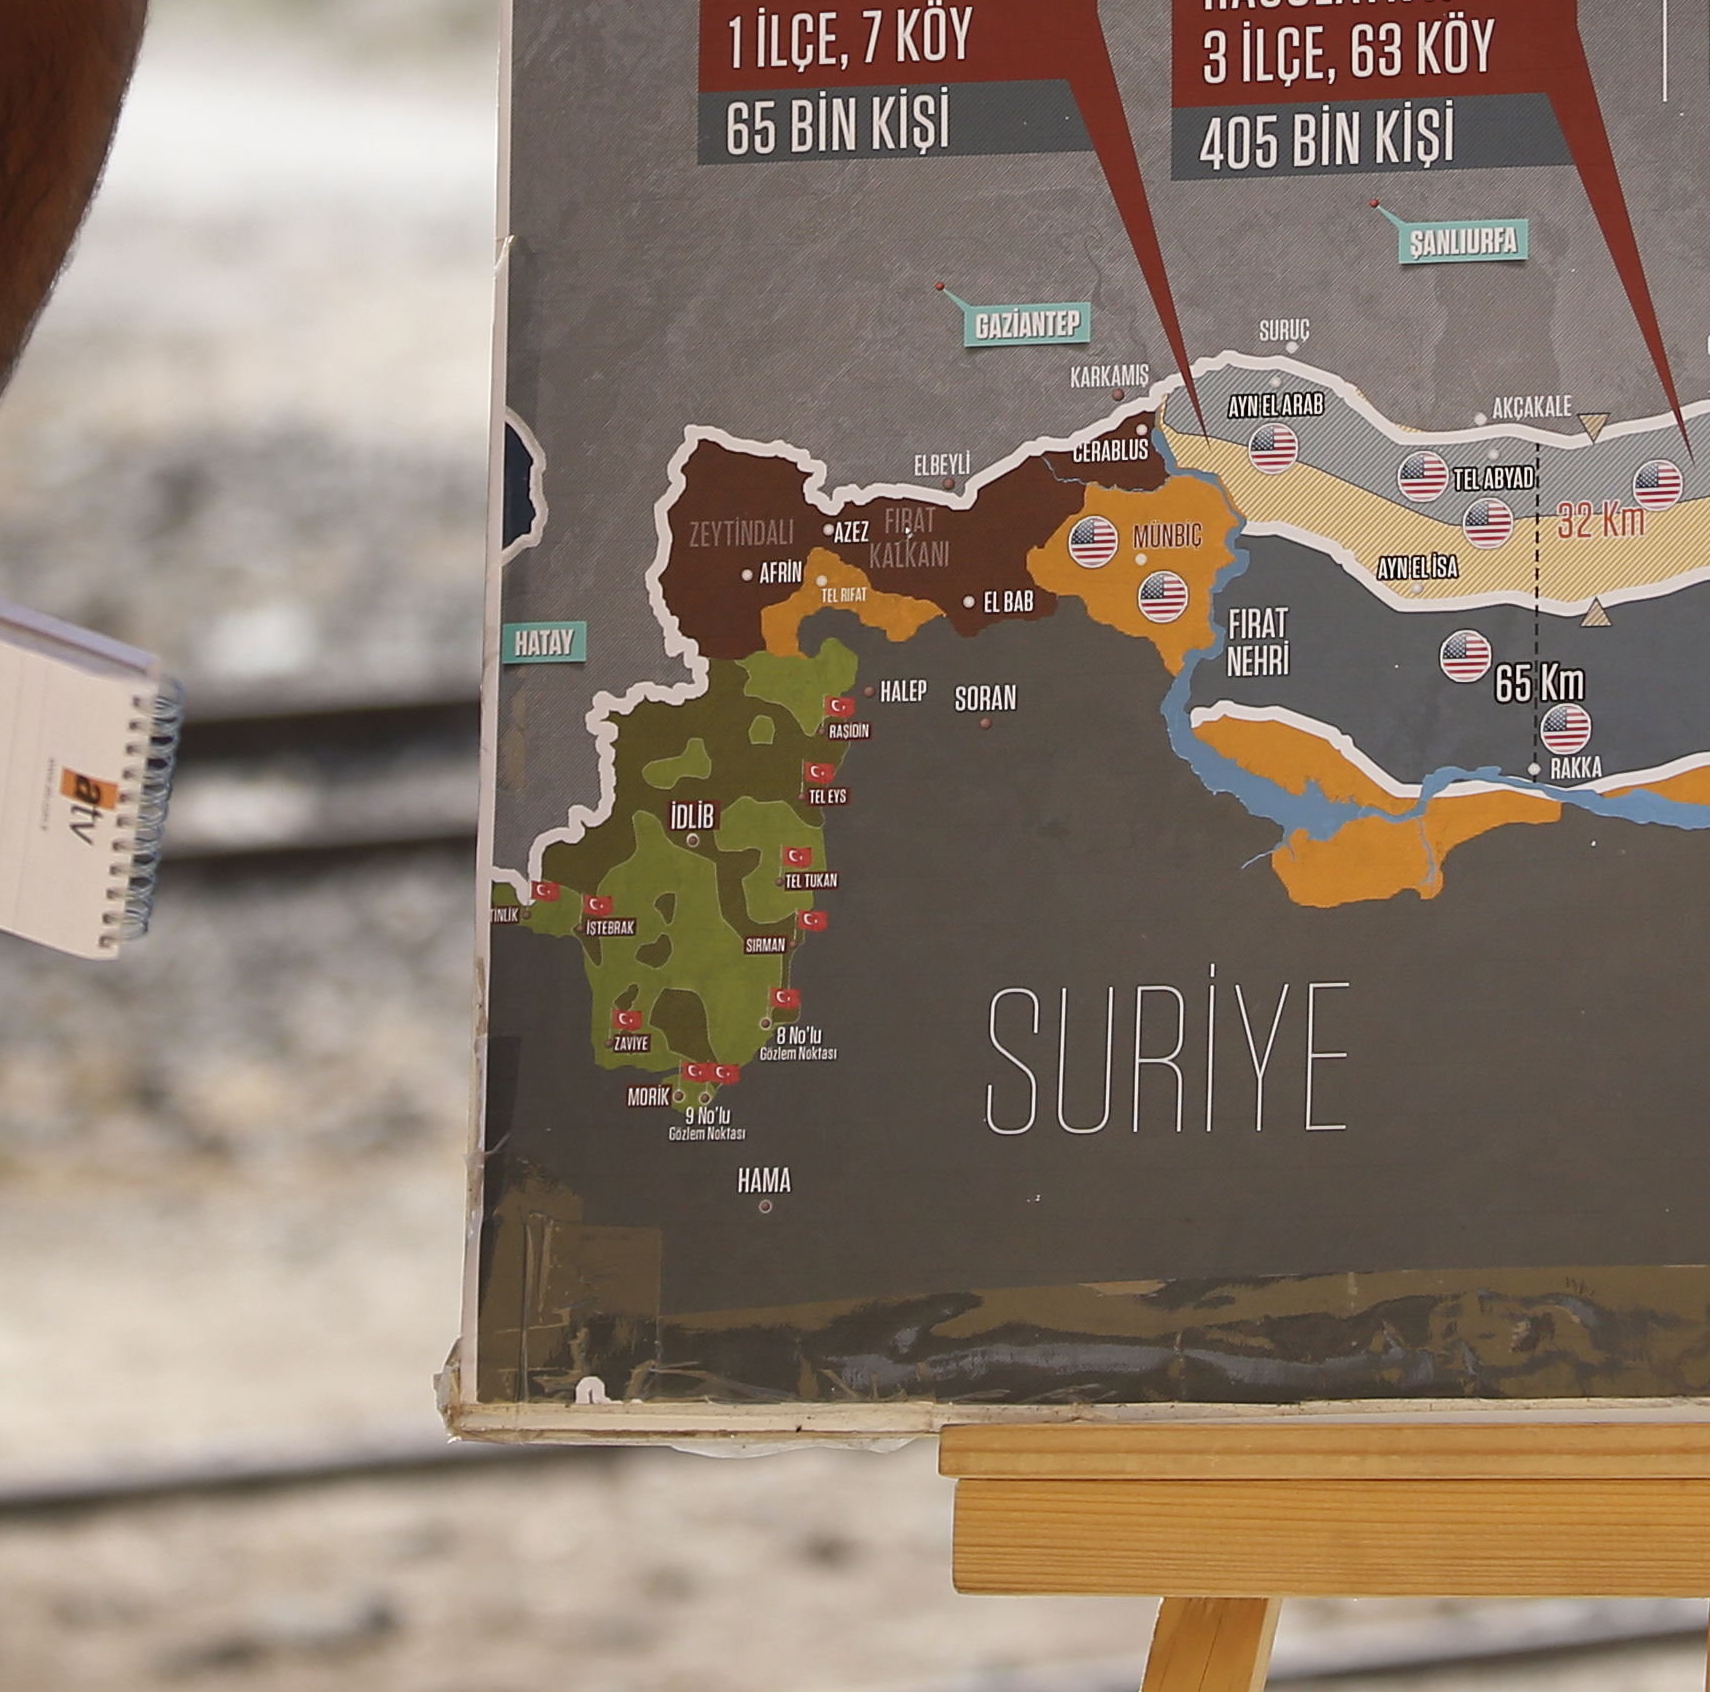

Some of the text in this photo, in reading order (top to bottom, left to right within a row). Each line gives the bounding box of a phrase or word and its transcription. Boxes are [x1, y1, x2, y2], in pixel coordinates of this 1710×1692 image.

[729, 0, 973, 73] 1 İLÇE, 7 KÖY
[1203, 11, 1495, 87] 3 İLÇE, 63 KÖY
[726, 86, 949, 155] 65 BİN KİŞİ
[1199, 99, 1453, 171] 405 BİN KİŞİ
[1410, 227, 1518, 260] ŞANLIURFA
[975, 308, 1081, 340] GAZİANTEP
[1259, 318, 1310, 342] SURUÇ
[1070, 364, 1149, 388] KARKAMIŞ
[1229, 393, 1324, 417] AYN EL ARAB
[1493, 395, 1572, 421] AKÇAKALE
[913, 450, 971, 477] ELBEYLİ
[1073, 438, 1149, 463] CERABLUS
[1454, 466, 1534, 491] TEL ABYAD
[834, 520, 869, 543] AZEZ
[885, 507, 935, 534] FIRAT
[1558, 499, 1645, 539] 32 Km
[689, 517, 794, 548] ZEYTİNDALI
[870, 541, 950, 569] KALKANI
[1378, 553, 1458, 579] AYN EL İSA
[759, 559, 803, 584] AFRİN
[821, 587, 868, 604] TEL RIFAT
[984, 590, 1034, 613] EL BAB
[1229, 607, 1289, 640] FIRAT
[515, 629, 574, 657] HATAY
[1227, 640, 1289, 677] NEHRİ
[880, 679, 927, 702] HALEP
[1496, 663, 1584, 702] 65 Km
[955, 684, 1017, 712] SORAN
[1551, 756, 1602, 779] RAKKA
[68, 772, 103, 846] atv
[809, 789, 847, 804] TEL EYS
[671, 800, 714, 830] İDLİB
[785, 873, 838, 889] TEL TUKAN
[776, 1027, 786, 1045] 8
[987, 963, 1350, 1135] SURİYE
[759, 1046, 837, 1062] Gözlem Noktası
[627, 1086, 670, 1106] MORİK
[685, 1107, 694, 1125] 9
[669, 1126, 746, 1141] Gözlem Noktası
[737, 1167, 791, 1193] HAMA
